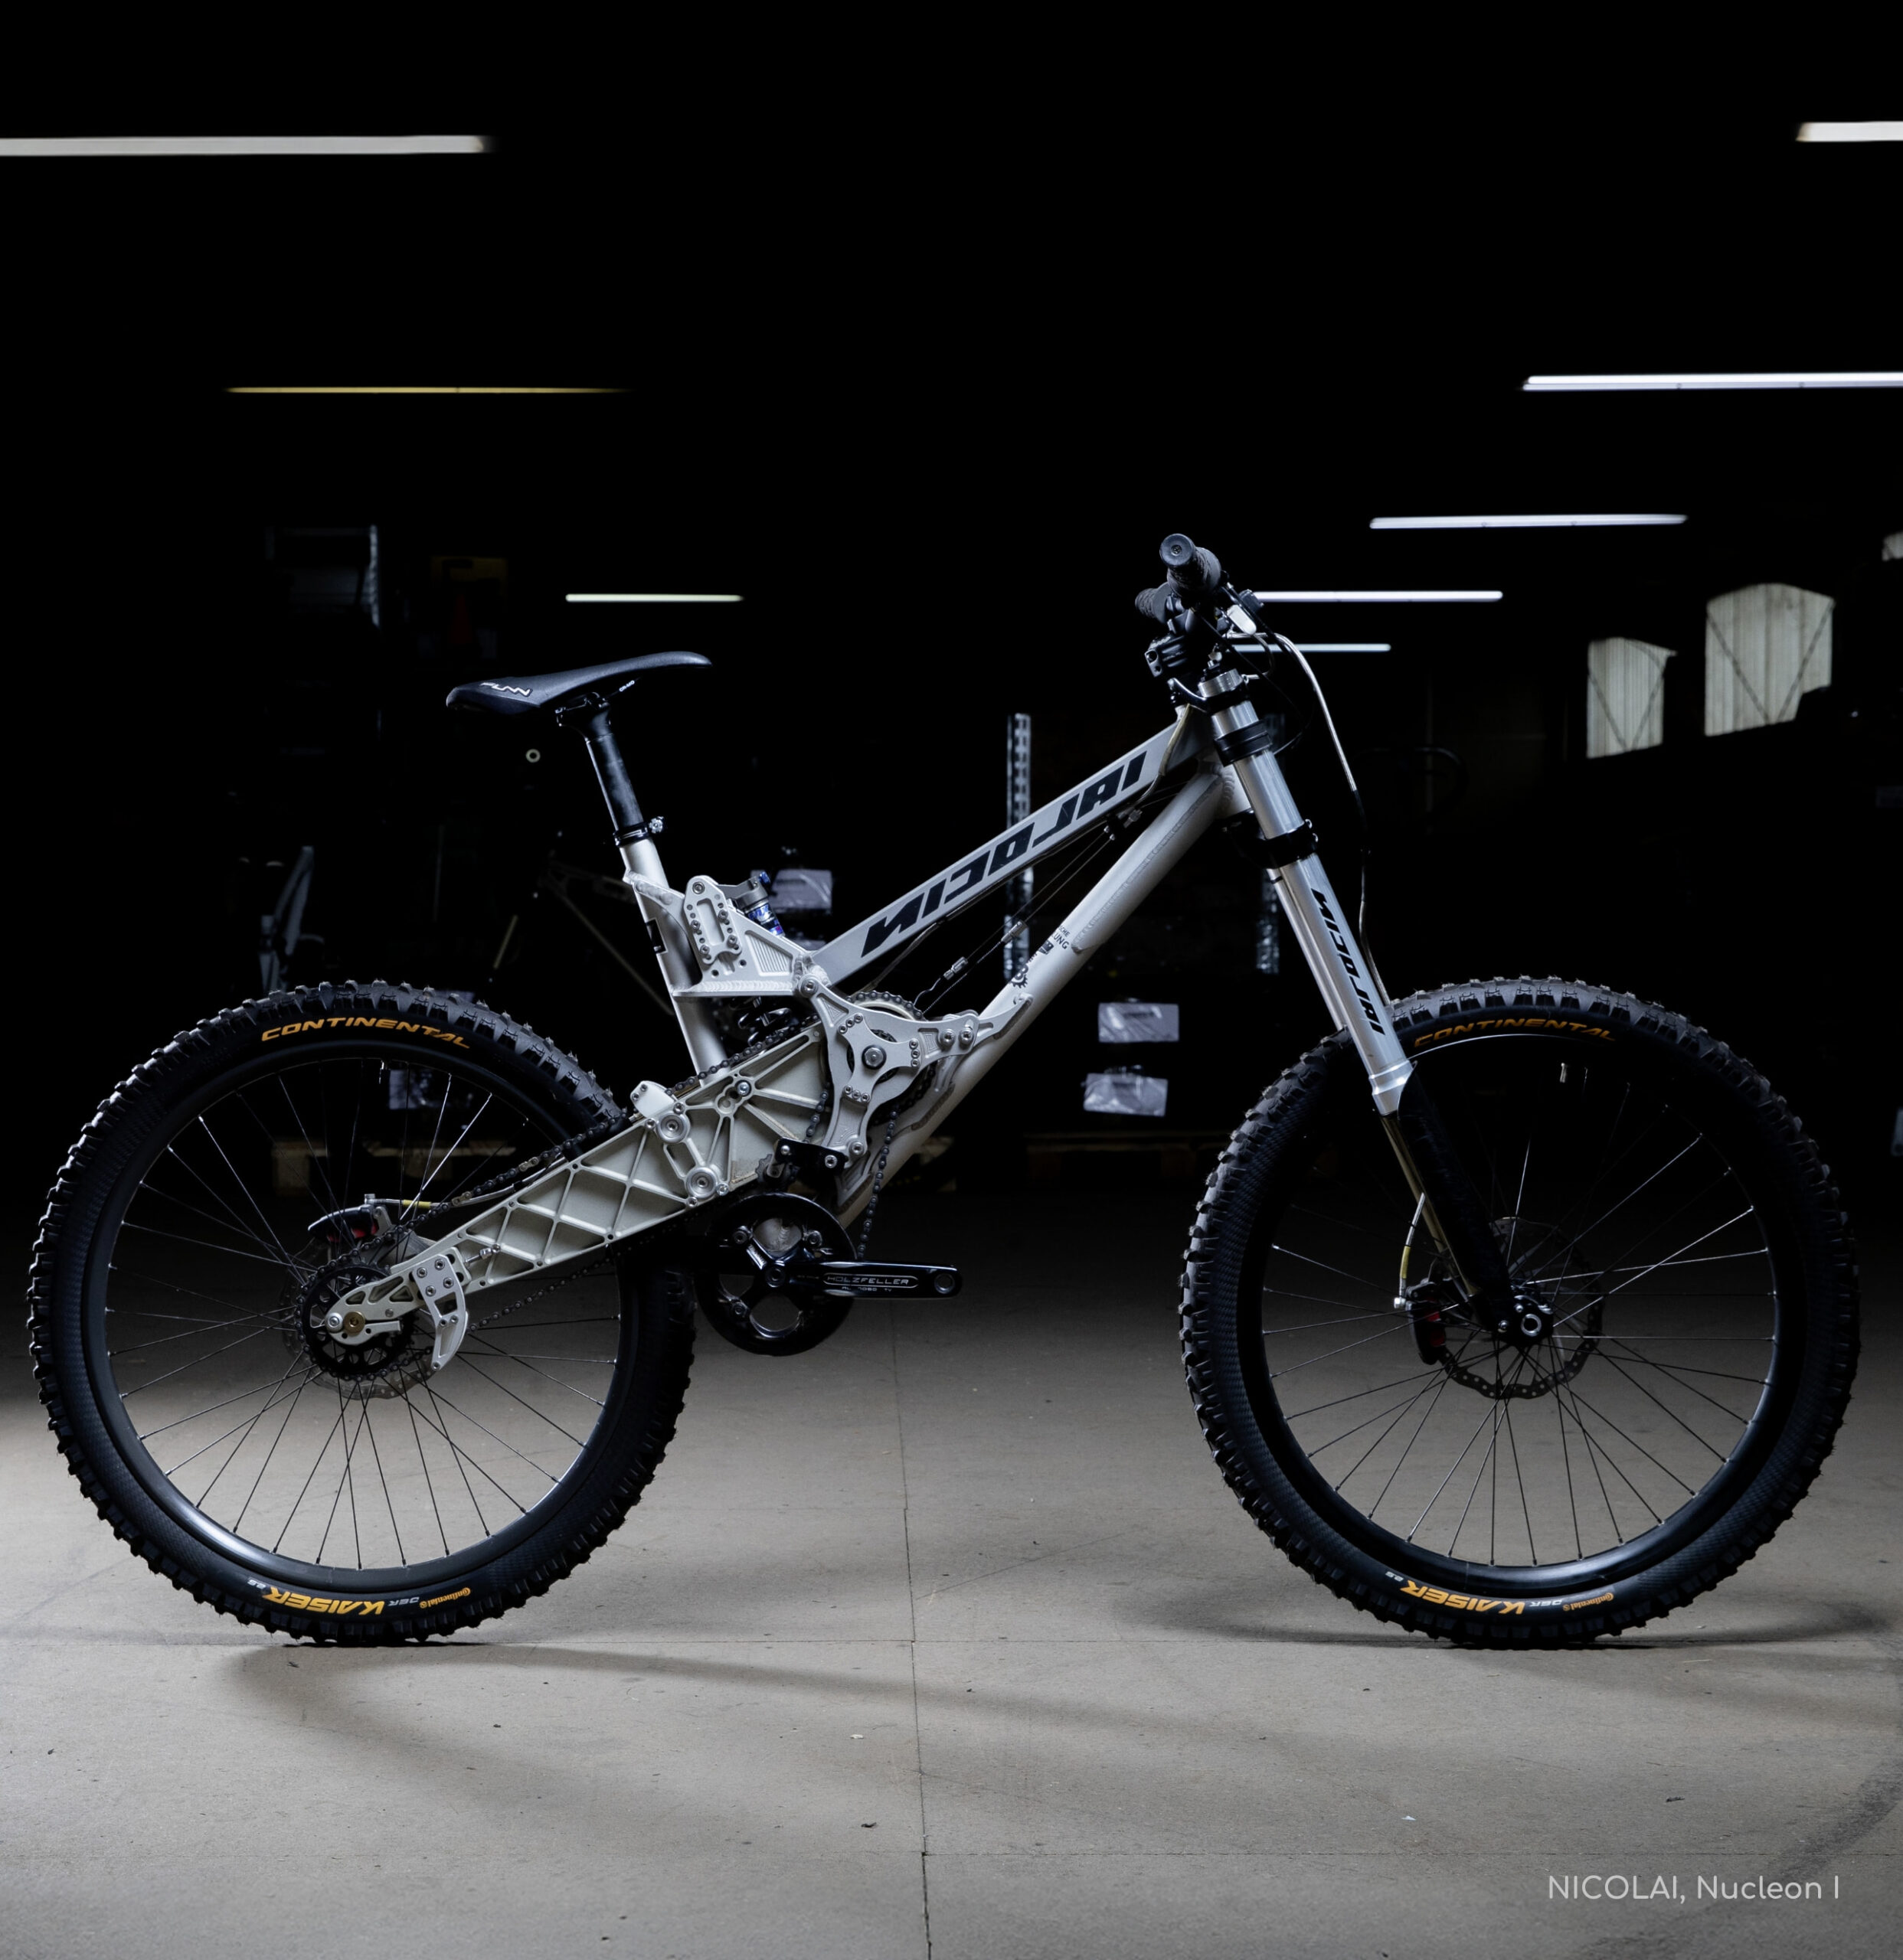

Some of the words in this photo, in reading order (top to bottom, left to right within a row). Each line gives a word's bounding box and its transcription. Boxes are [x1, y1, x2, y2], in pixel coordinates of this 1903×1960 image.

[261, 1017, 470, 1049] CONTINENTAL
[1414, 1018, 1617, 1048] CONTINENTAL
[827, 1276, 909, 1285] HOLZFELLER
[262, 1586, 385, 1616] KAISER
[388, 1596, 420, 1606] DER
[1400, 1579, 1526, 1615] KAISER
